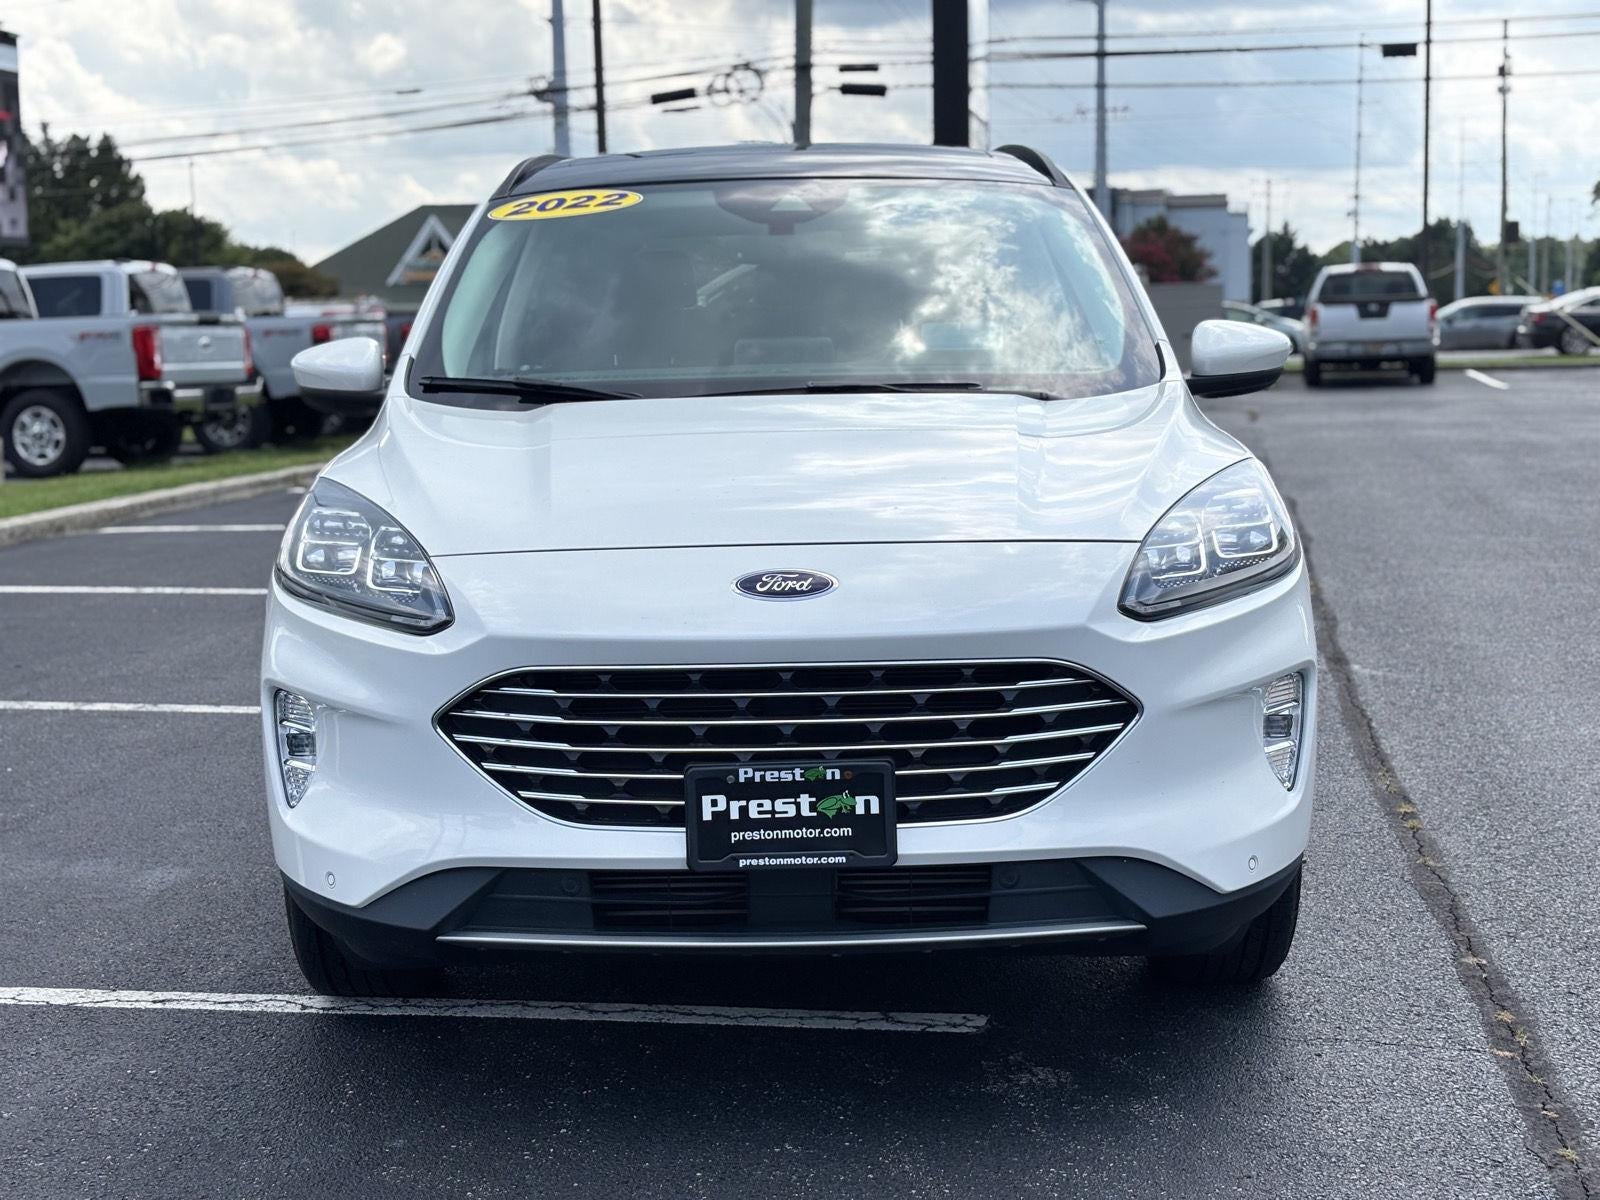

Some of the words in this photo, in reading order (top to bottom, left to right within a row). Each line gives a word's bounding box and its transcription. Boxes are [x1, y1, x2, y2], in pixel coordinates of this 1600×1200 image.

[503, 192, 629, 217] 2022
[755, 573, 813, 592] Ford
[731, 827, 852, 844] prestonmotor.com
[739, 855, 846, 867] prestonmotor.com
